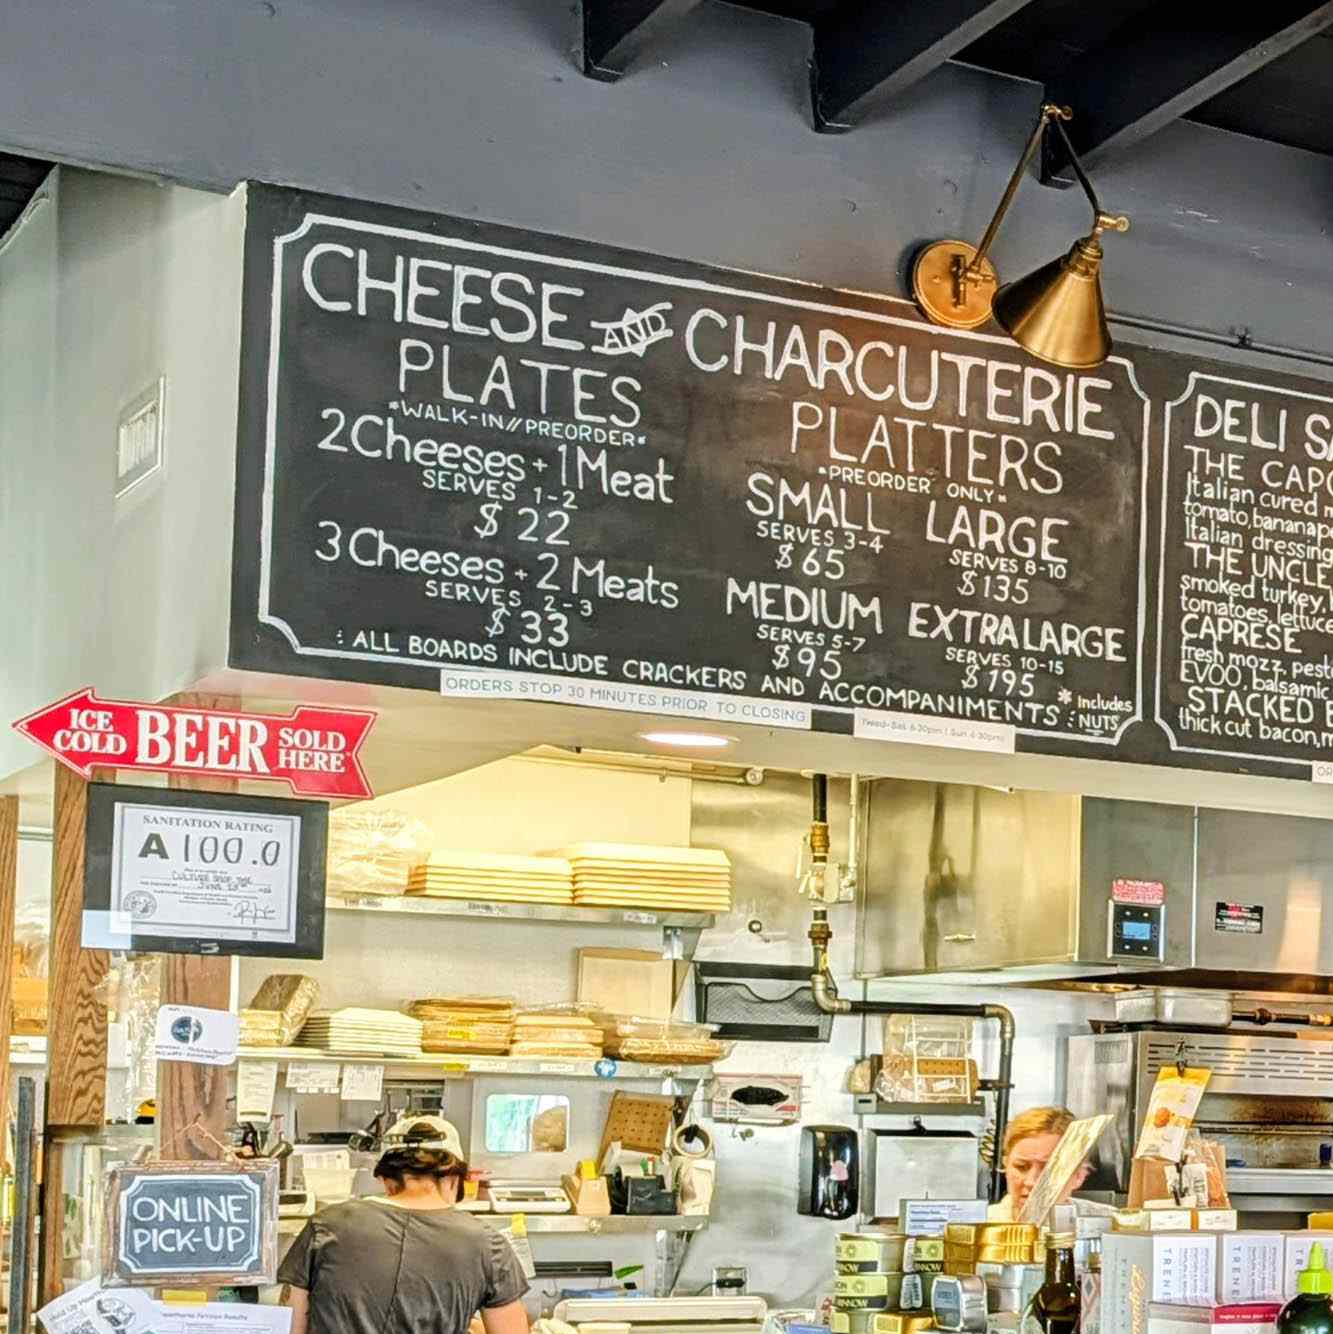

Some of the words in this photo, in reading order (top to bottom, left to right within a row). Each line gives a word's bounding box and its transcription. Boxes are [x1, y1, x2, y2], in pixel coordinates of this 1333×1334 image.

[302, 242, 585, 352] CHEESE
[601, 311, 667, 350] AND
[684, 308, 1115, 440] CHARCUTERIE
[399, 338, 642, 428] PLATES
[1194, 394, 1288, 452] DELI
[791, 401, 1063, 495] PLATTERS
[1184, 445, 1244, 481] THE
[422, 470, 516, 501] SERVES
[947, 483, 994, 503] ONLY
[1186, 471, 1255, 503] Italian
[1260, 489, 1318, 517] cured
[745, 472, 890, 535] SMALL
[926, 500, 1069, 564] LARGE
[756, 520, 835, 547] SERVES
[843, 532, 884, 554] 3-4
[1185, 517, 1244, 549] Italian
[1252, 530, 1333, 567] dressing
[349, 527, 505, 585] Cheeses
[572, 556, 680, 608] Meats
[949, 548, 1019, 575] SERVES
[1024, 561, 1067, 580] 8-10
[1184, 542, 1243, 575] THE
[1252, 553, 1330, 589] UNCLE
[425, 580, 522, 608] SERVES
[1181, 573, 1255, 602] smoked
[725, 577, 883, 635] MEDIUM
[757, 624, 828, 648] SERVES
[1181, 614, 1302, 654] CAPRESE
[945, 647, 1012, 669] SERVES
[353, 630, 400, 654] ALL
[409, 636, 497, 663] BOARDS
[509, 648, 608, 676] INCLUDE
[622, 660, 746, 691] CRACKERS
[761, 669, 805, 696] AND
[819, 680, 1060, 725] ACCOMPANIMENTS
[1252, 671, 1329, 702] balsamic
[446, 677, 513, 693] ORDERS
[519, 681, 561, 695] STOP
[590, 688, 657, 707] MINUTES
[662, 696, 708, 712] PRIOR
[742, 704, 806, 722] CLOSING
[1188, 686, 1314, 725] STACKED
[70, 708, 114, 733] ICE
[53, 730, 127, 756] COLD
[135, 709, 271, 774] BEER
[278, 728, 345, 753] SOLD
[278, 751, 345, 773] HERE
[143, 814, 222, 831] SANITATION
[226, 817, 274, 835] RATING
[138, 832, 170, 860] A
[132, 1193, 250, 1225] ONLINE
[133, 1225, 247, 1255] PICK-UP
